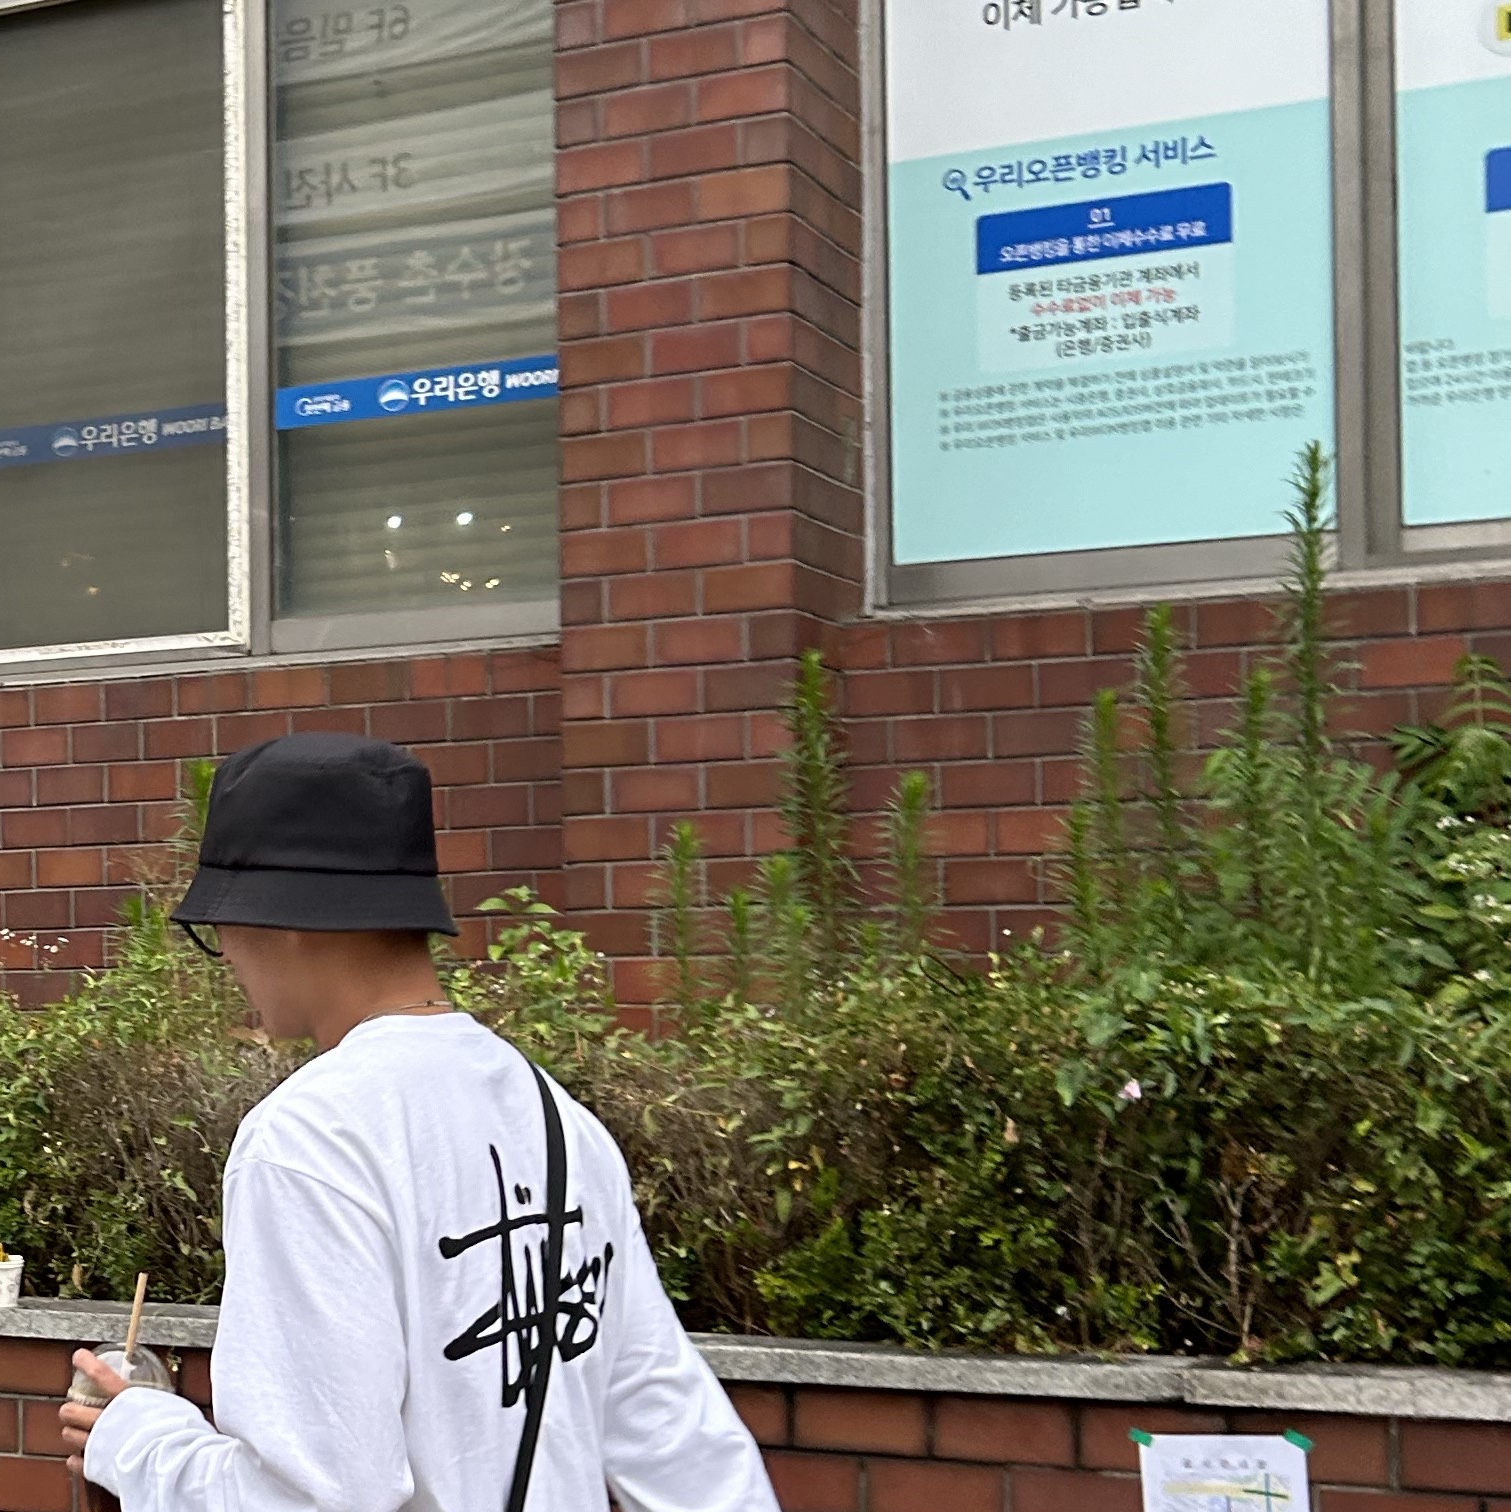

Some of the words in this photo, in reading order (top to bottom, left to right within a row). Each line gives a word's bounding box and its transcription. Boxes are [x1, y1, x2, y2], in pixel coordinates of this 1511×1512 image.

[973, 145, 1128, 192] 우리오픈뱅킹
[1135, 136, 1217, 168] 서비스
[1089, 206, 1113, 224] 01
[411, 369, 502, 406] 우리은행
[79, 418, 159, 451] 우리은행
